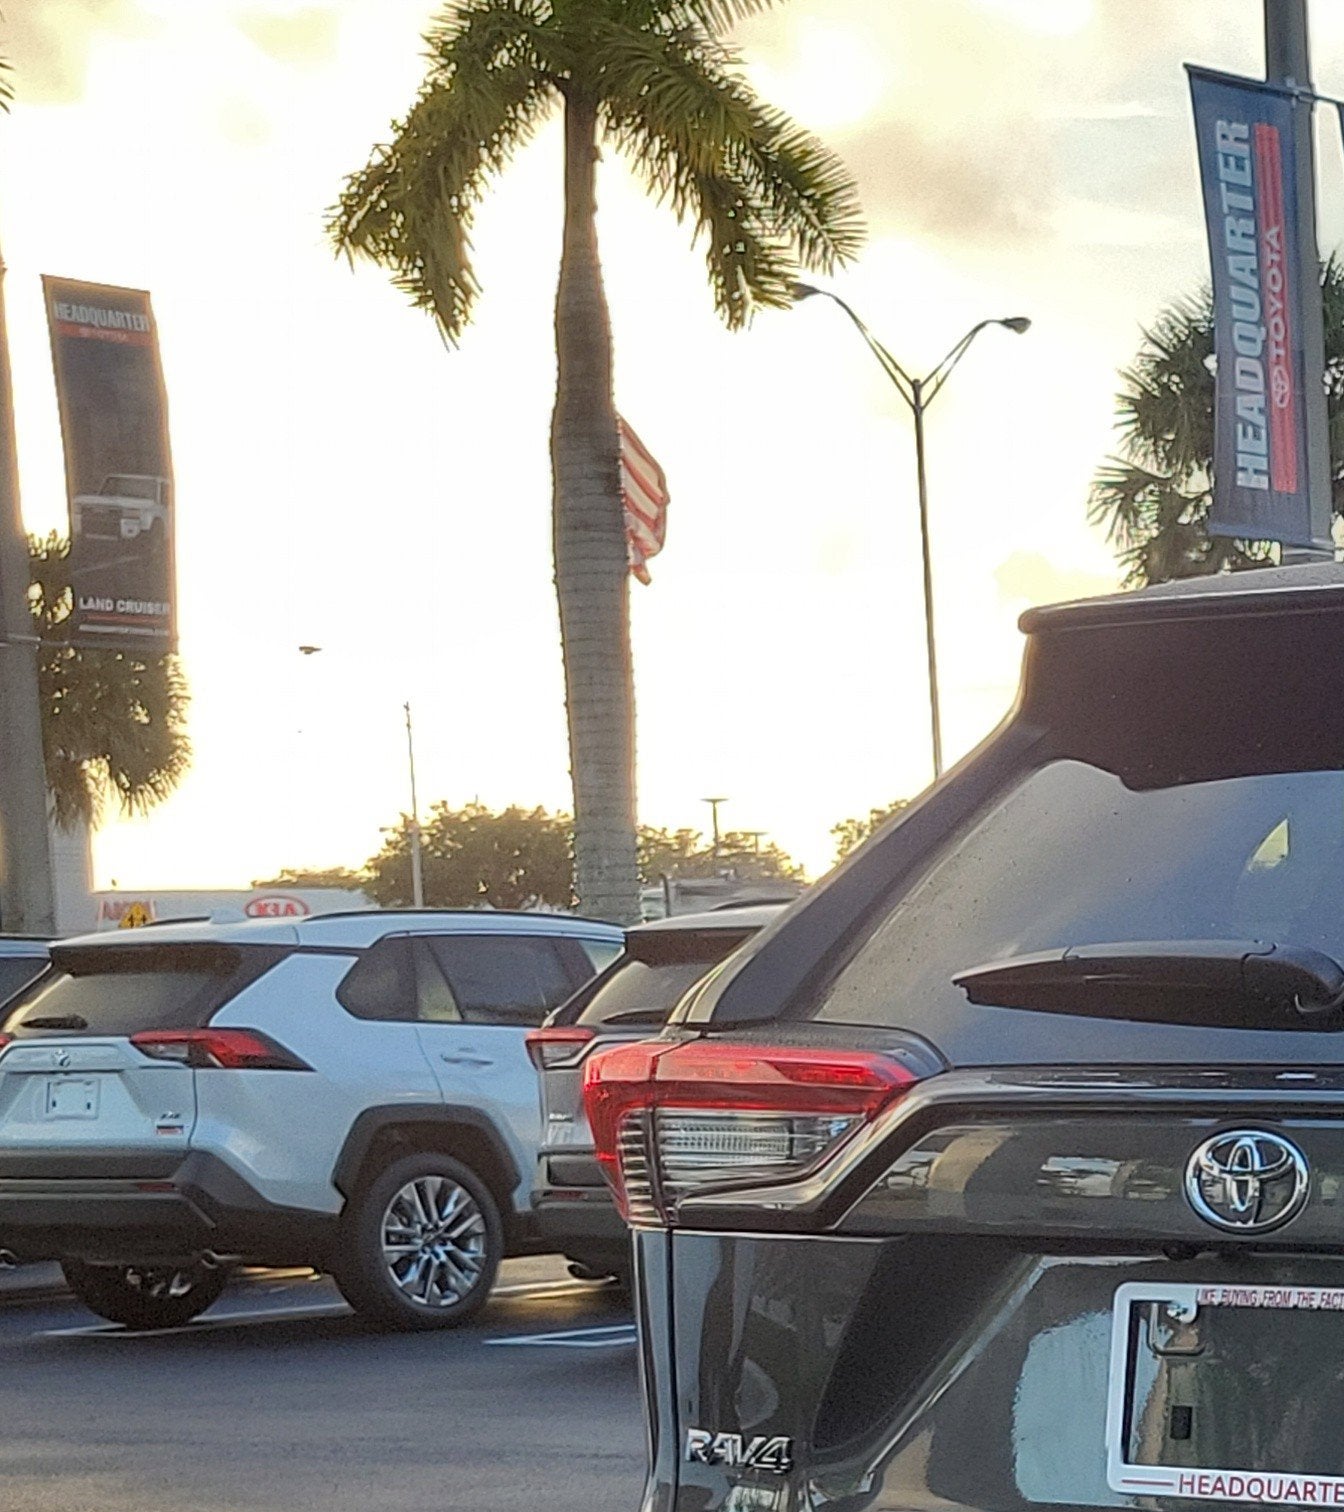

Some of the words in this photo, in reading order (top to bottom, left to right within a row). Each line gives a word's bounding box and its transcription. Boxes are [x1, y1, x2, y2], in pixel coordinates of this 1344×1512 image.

[1216, 120, 1270, 491] HEADQUARTER
[1265, 226, 1287, 358] TOYOTA
[54, 301, 149, 332] HEADQUARTER
[79, 597, 114, 612] LAND
[1220, 1289, 1258, 1307] BUYING
[1263, 1291, 1292, 1309] FROM
[1296, 1292, 1317, 1309] THE
[685, 1428, 793, 1474] RAV4
